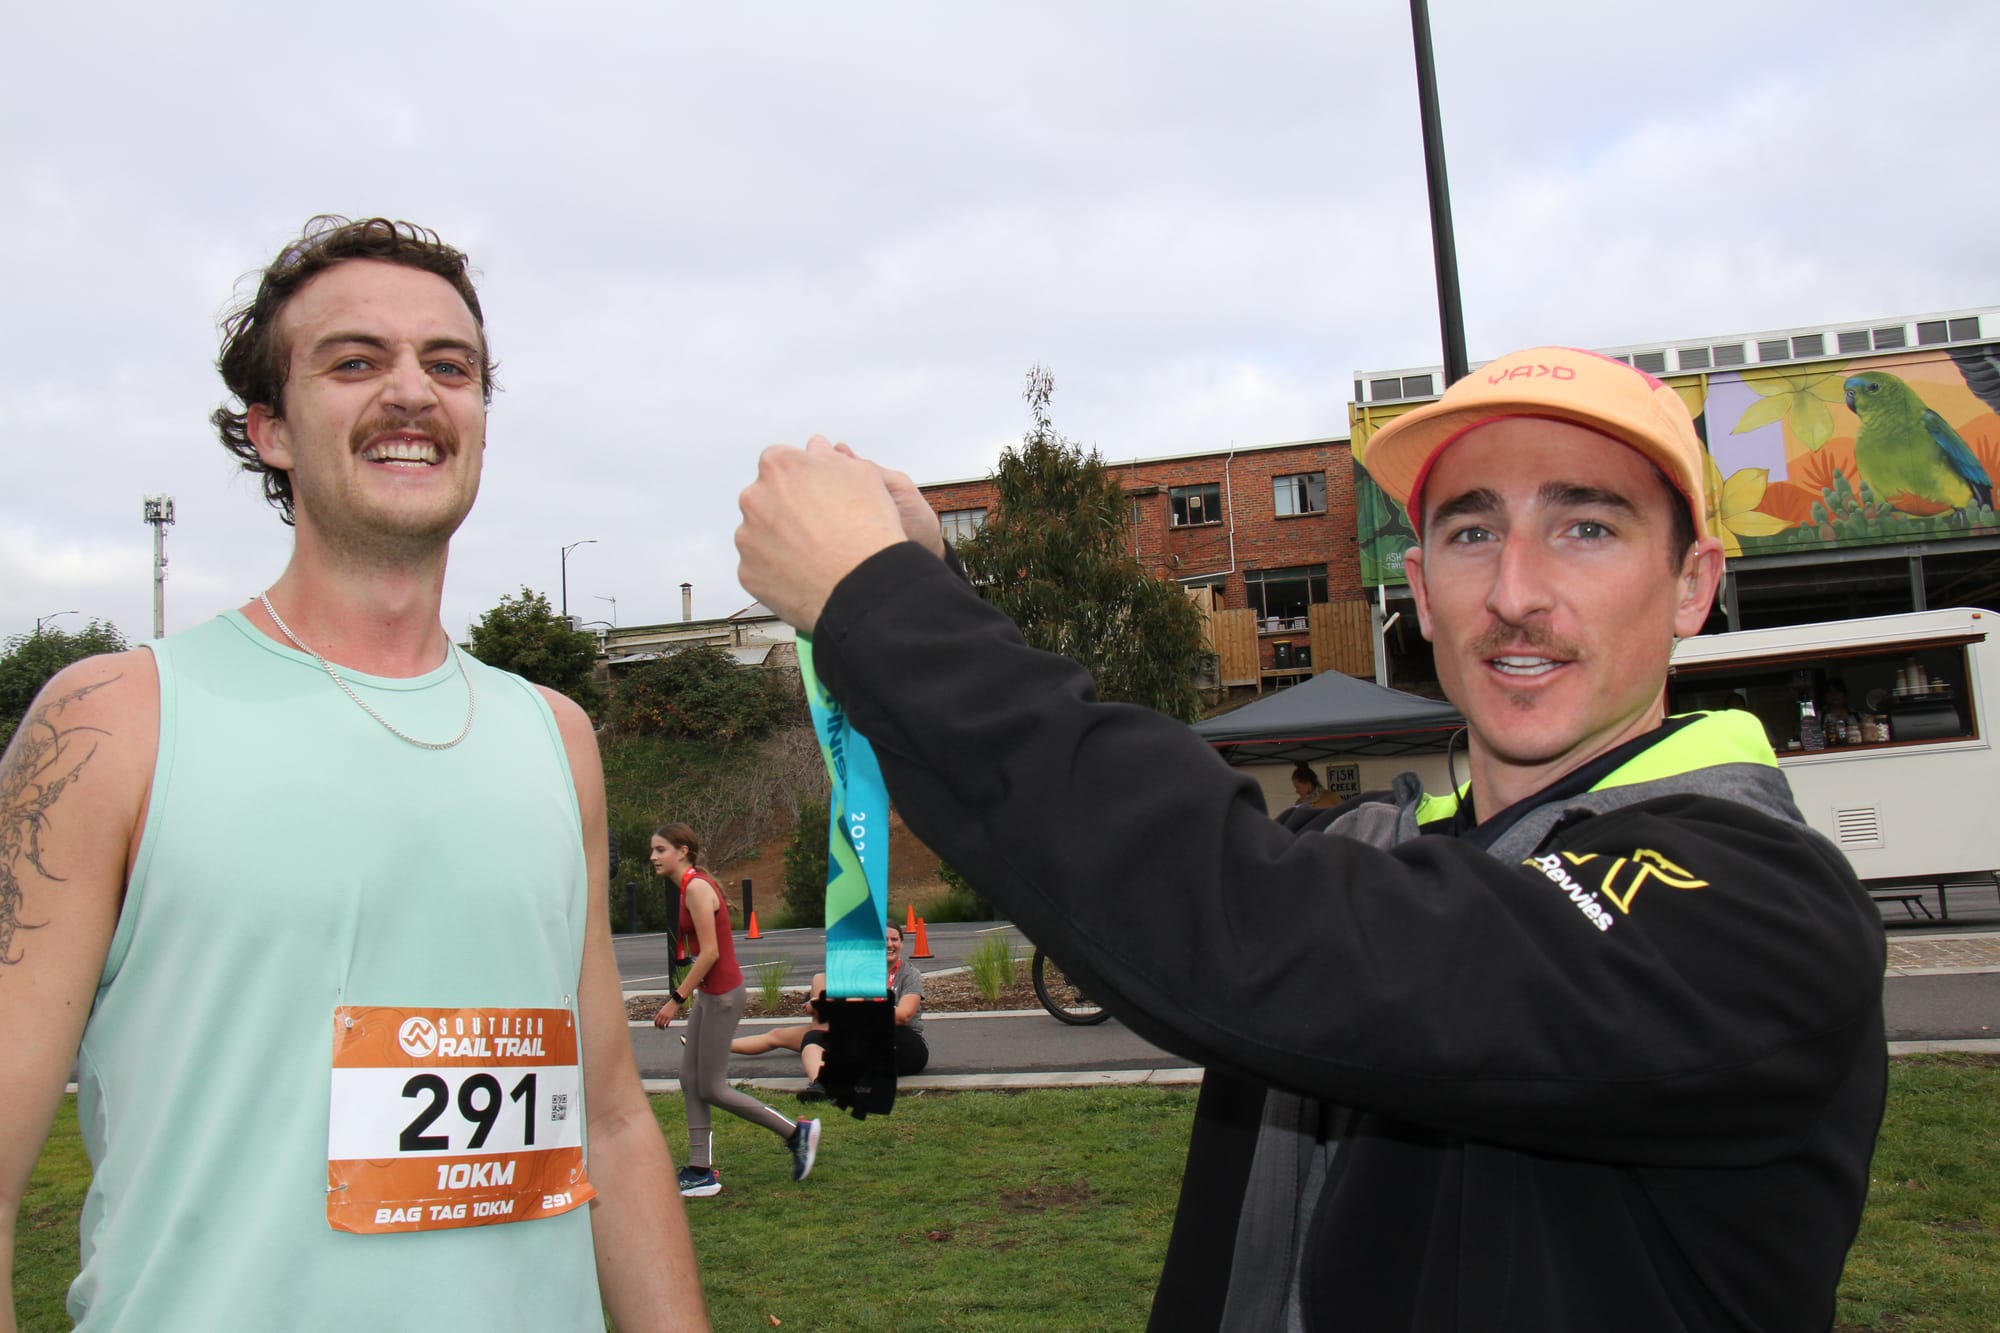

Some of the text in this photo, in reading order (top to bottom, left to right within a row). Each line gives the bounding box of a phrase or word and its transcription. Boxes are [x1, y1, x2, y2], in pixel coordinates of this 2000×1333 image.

[824, 694, 848, 790] FINIS
[1329, 769, 1354, 782] FISH
[851, 812, 866, 864] 202
[1534, 853, 1614, 932] Revvies
[439, 1017, 544, 1035] SOUTHERN
[438, 1037, 546, 1057] RAIL TRAIL
[399, 1073, 537, 1152] 291
[436, 1160, 516, 1190] 10KM
[375, 1192, 573, 1223] BAG TAG 10KM 291
